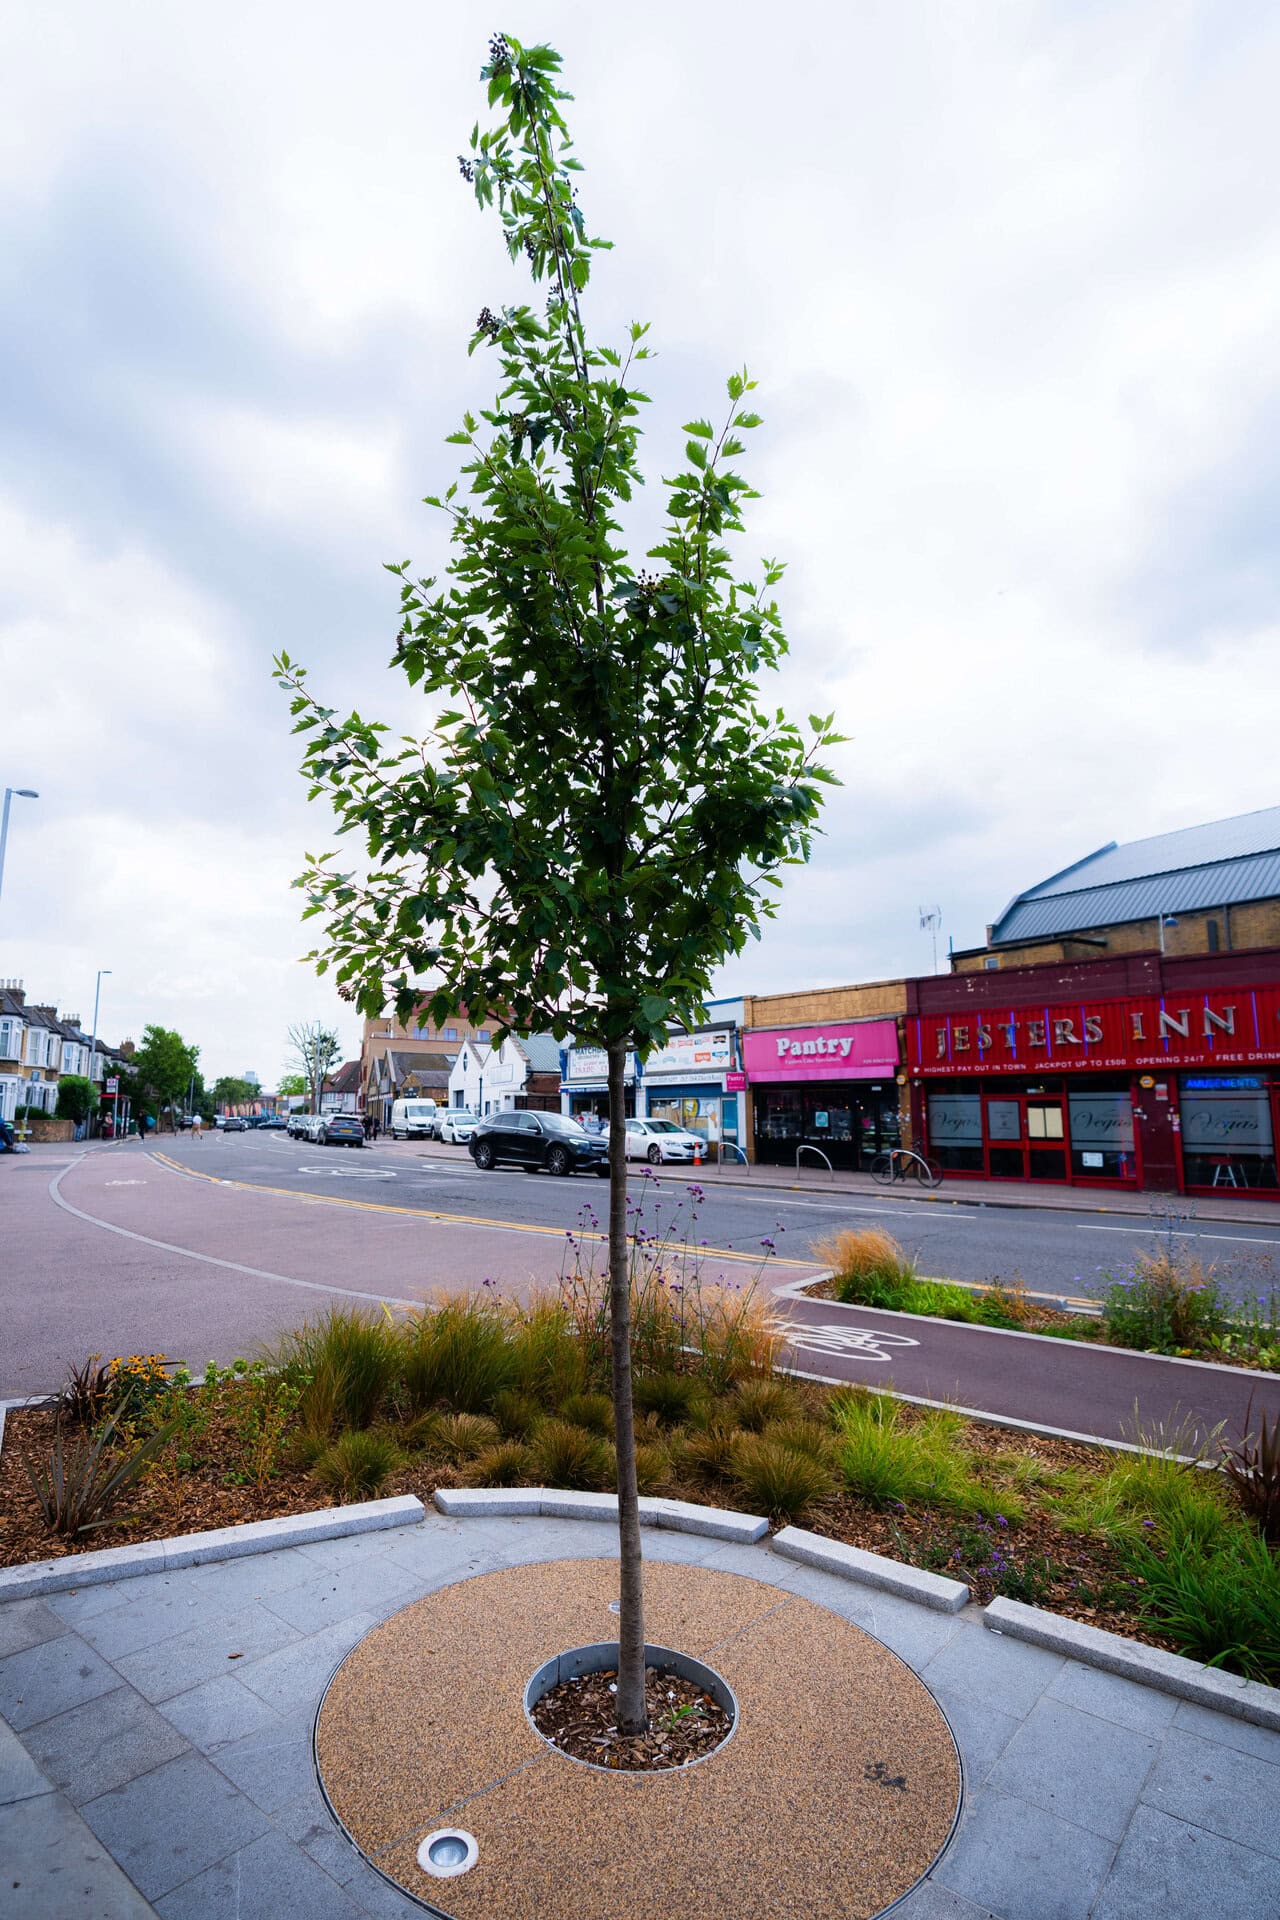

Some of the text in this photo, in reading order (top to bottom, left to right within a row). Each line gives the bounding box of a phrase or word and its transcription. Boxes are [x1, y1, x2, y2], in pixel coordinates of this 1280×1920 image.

[936, 1016, 1103, 1059] JESTERS
[1129, 1005, 1236, 1040] INN
[776, 1036, 854, 1057] Pantry
[1135, 1055, 1205, 1065] OPENING 24/7
[1215, 1053, 1244, 1062] FREE
[924, 1065, 955, 1073] HIGHEST
[1034, 1061, 1073, 1069] JACKPOT
[1105, 1058, 1127, 1066] £500
[1185, 1078, 1259, 1089] AMUSEMENTS
[1073, 1111, 1132, 1136] Vegas
[1191, 1111, 1259, 1137] Vegas
